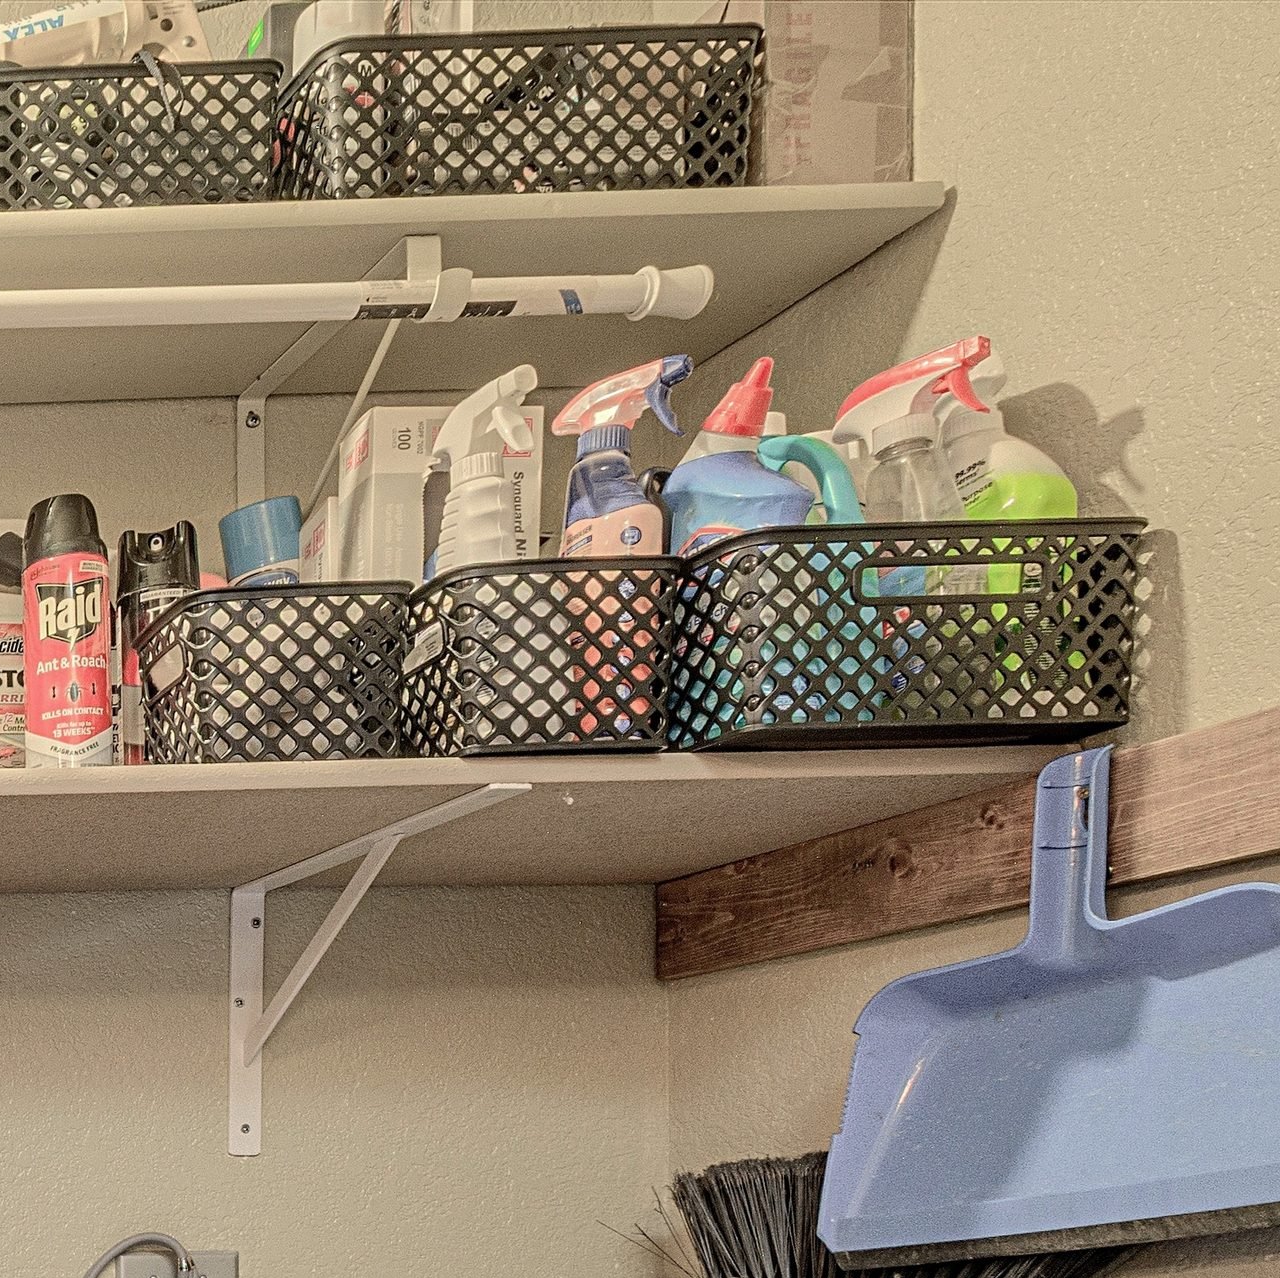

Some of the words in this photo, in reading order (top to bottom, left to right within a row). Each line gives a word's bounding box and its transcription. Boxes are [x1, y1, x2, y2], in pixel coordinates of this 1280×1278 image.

[397, 427, 411, 450] 100
[39, 586, 102, 641] Raid
[37, 658, 59, 675] Ant
[60, 657, 70, 669] &
[72, 654, 106, 669] Roach
[41, 710, 62, 721] KILLS
[62, 709, 73, 717] ON
[74, 707, 104, 717] CONTACT
[53, 728, 62, 738] 13
[50, 744, 86, 757] FRAGRANCE
[86, 741, 100, 752] FREE
